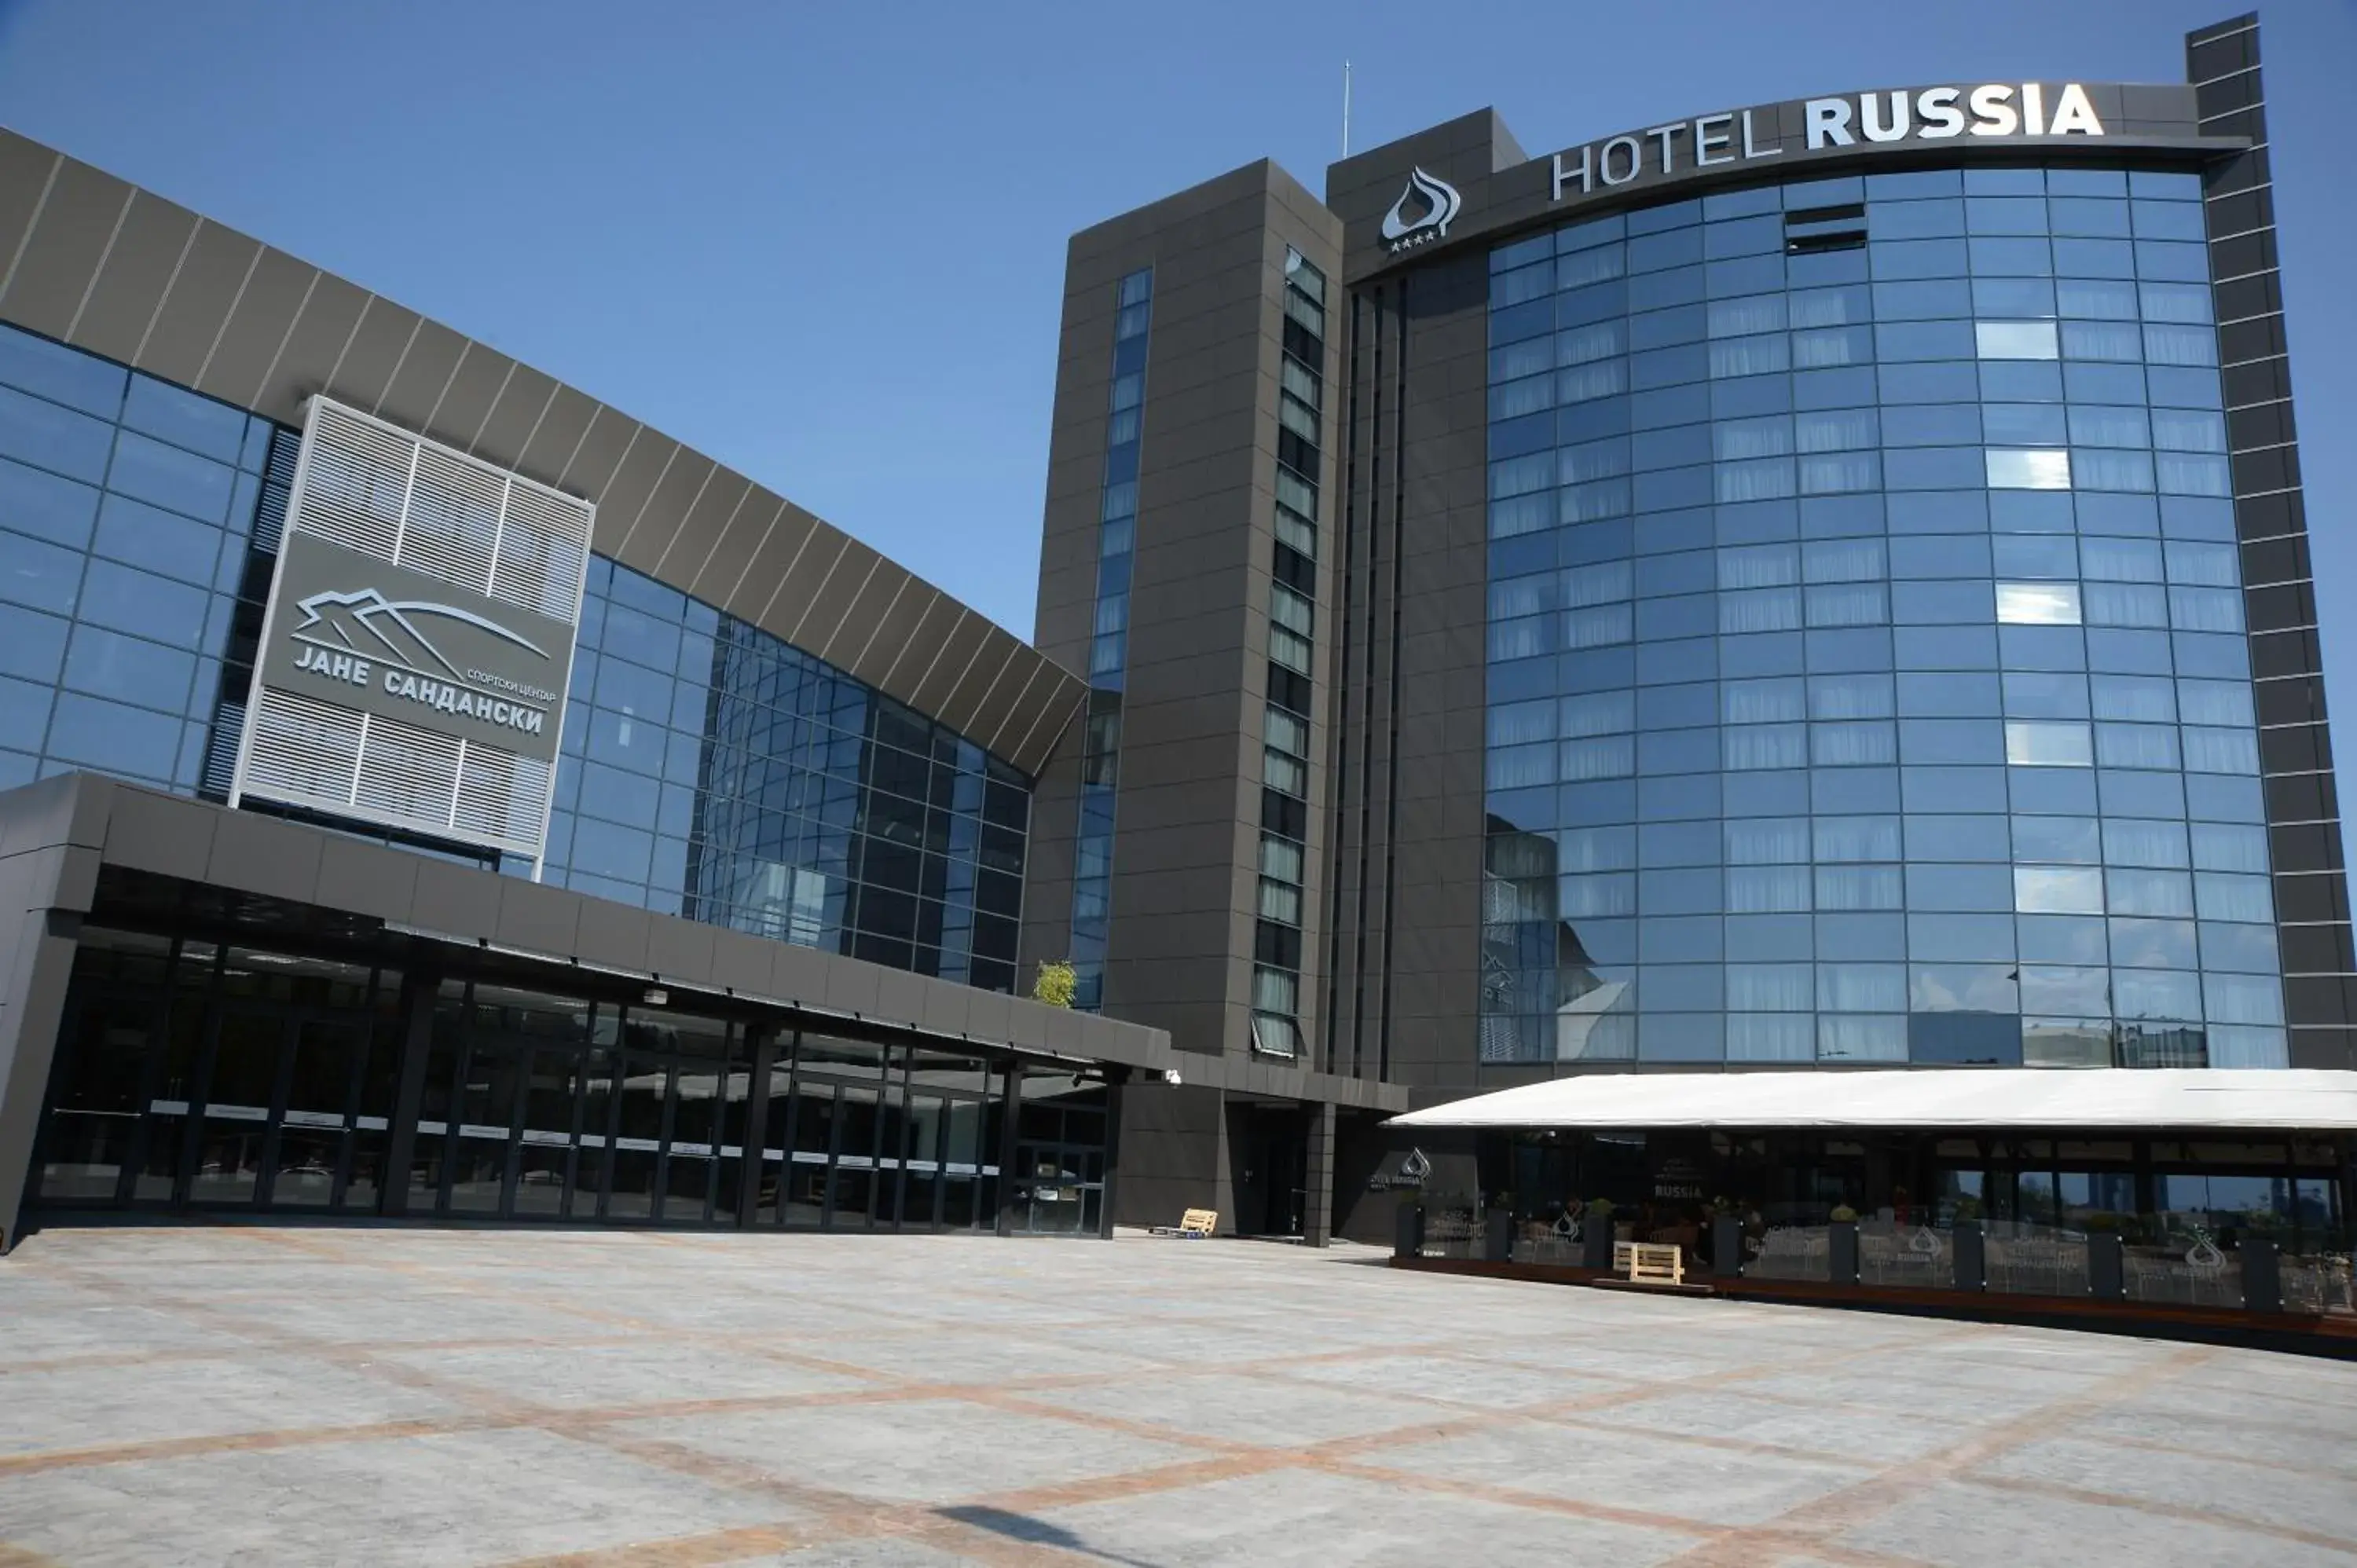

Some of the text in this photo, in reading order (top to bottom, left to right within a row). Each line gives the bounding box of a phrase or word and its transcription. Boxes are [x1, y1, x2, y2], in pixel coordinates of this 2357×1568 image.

[1552, 83, 2105, 202] HOTEL RUSSIA
[295, 647, 544, 735] ЈАНЕ САНДАНСКИ
[1654, 1184, 1704, 1199] RUSSIA
